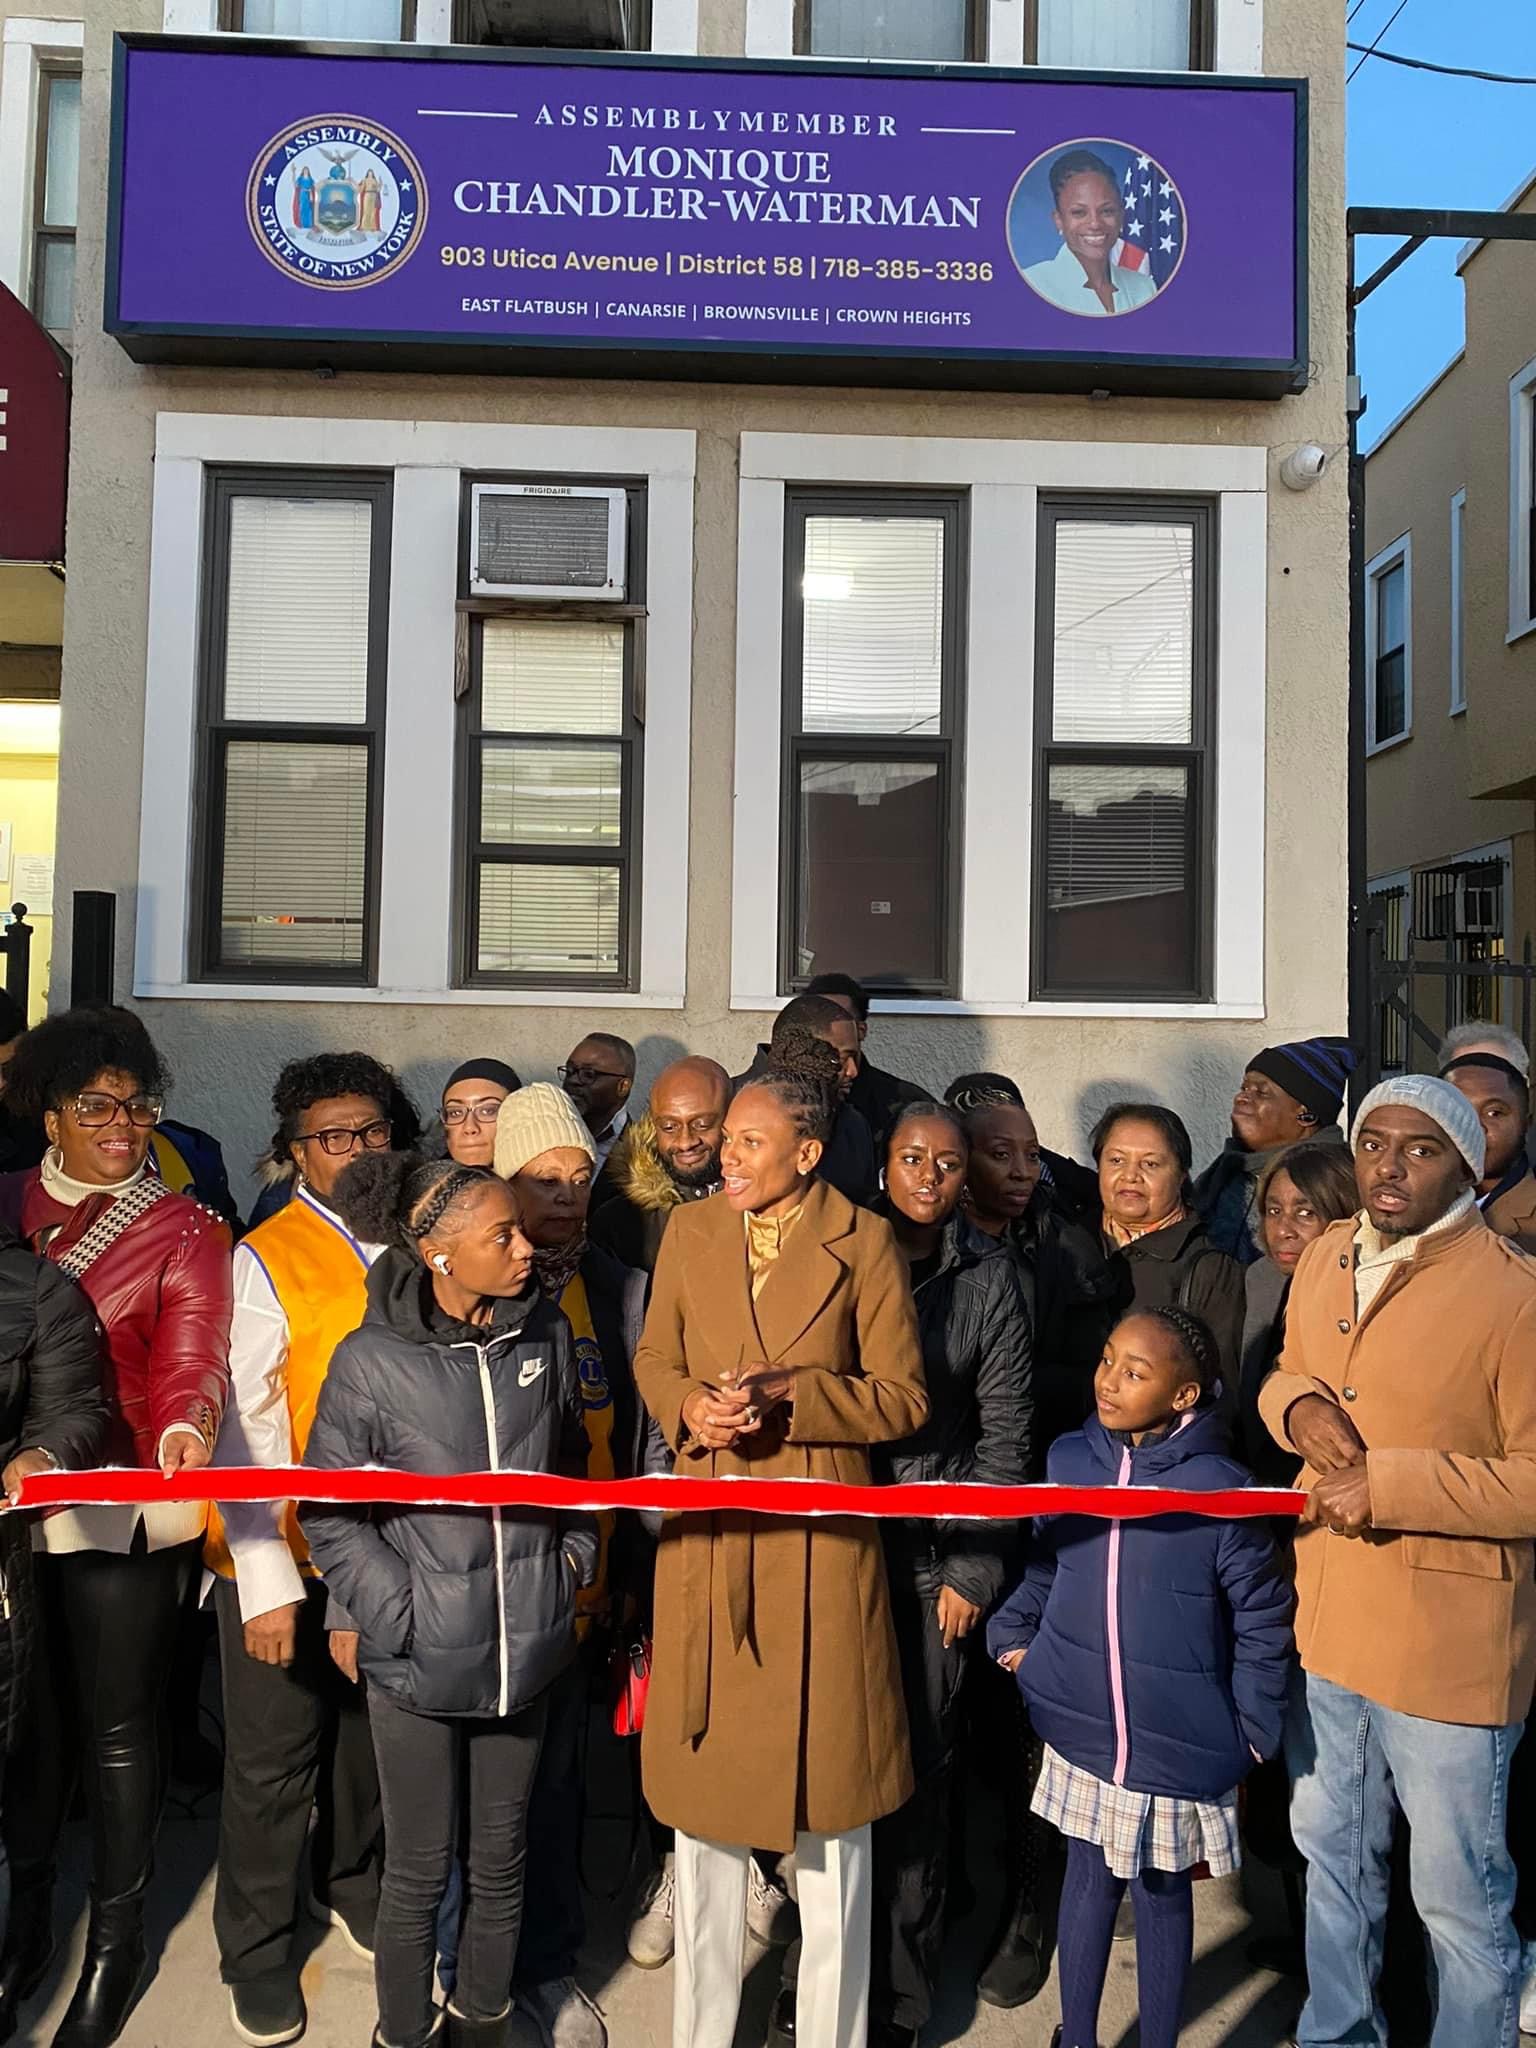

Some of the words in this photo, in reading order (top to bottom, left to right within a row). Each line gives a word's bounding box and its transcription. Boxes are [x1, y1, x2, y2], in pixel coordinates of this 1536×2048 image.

[535, 105, 897, 136] ASSEMBLYMEMBER
[283, 127, 397, 161] ASSEMBLY
[606, 145, 832, 188] MONIQUE
[453, 180, 982, 229] CHANDLER-WATERMAN
[261, 205, 298, 260] STATE
[299, 256, 327, 275] OF
[331, 256, 376, 277] NEW
[376, 211, 414, 260] YORK
[440, 246, 486, 267] 903
[493, 247, 557, 270] Utica
[563, 251, 659, 273] Avenue
[679, 253, 767, 275] District
[773, 257, 803, 277] 58
[823, 258, 993, 282] 718-385-3336
[462, 298, 501, 313] EAST
[505, 299, 588, 315] FLATBUSH
[606, 302, 686, 318] CANARSIE
[704, 305, 819, 321] BROWNSVILLE
[836, 308, 898, 324] CROWN
[903, 310, 971, 326] HEIGHTS
[523, 486, 572, 495] FRIGIDAIRE
